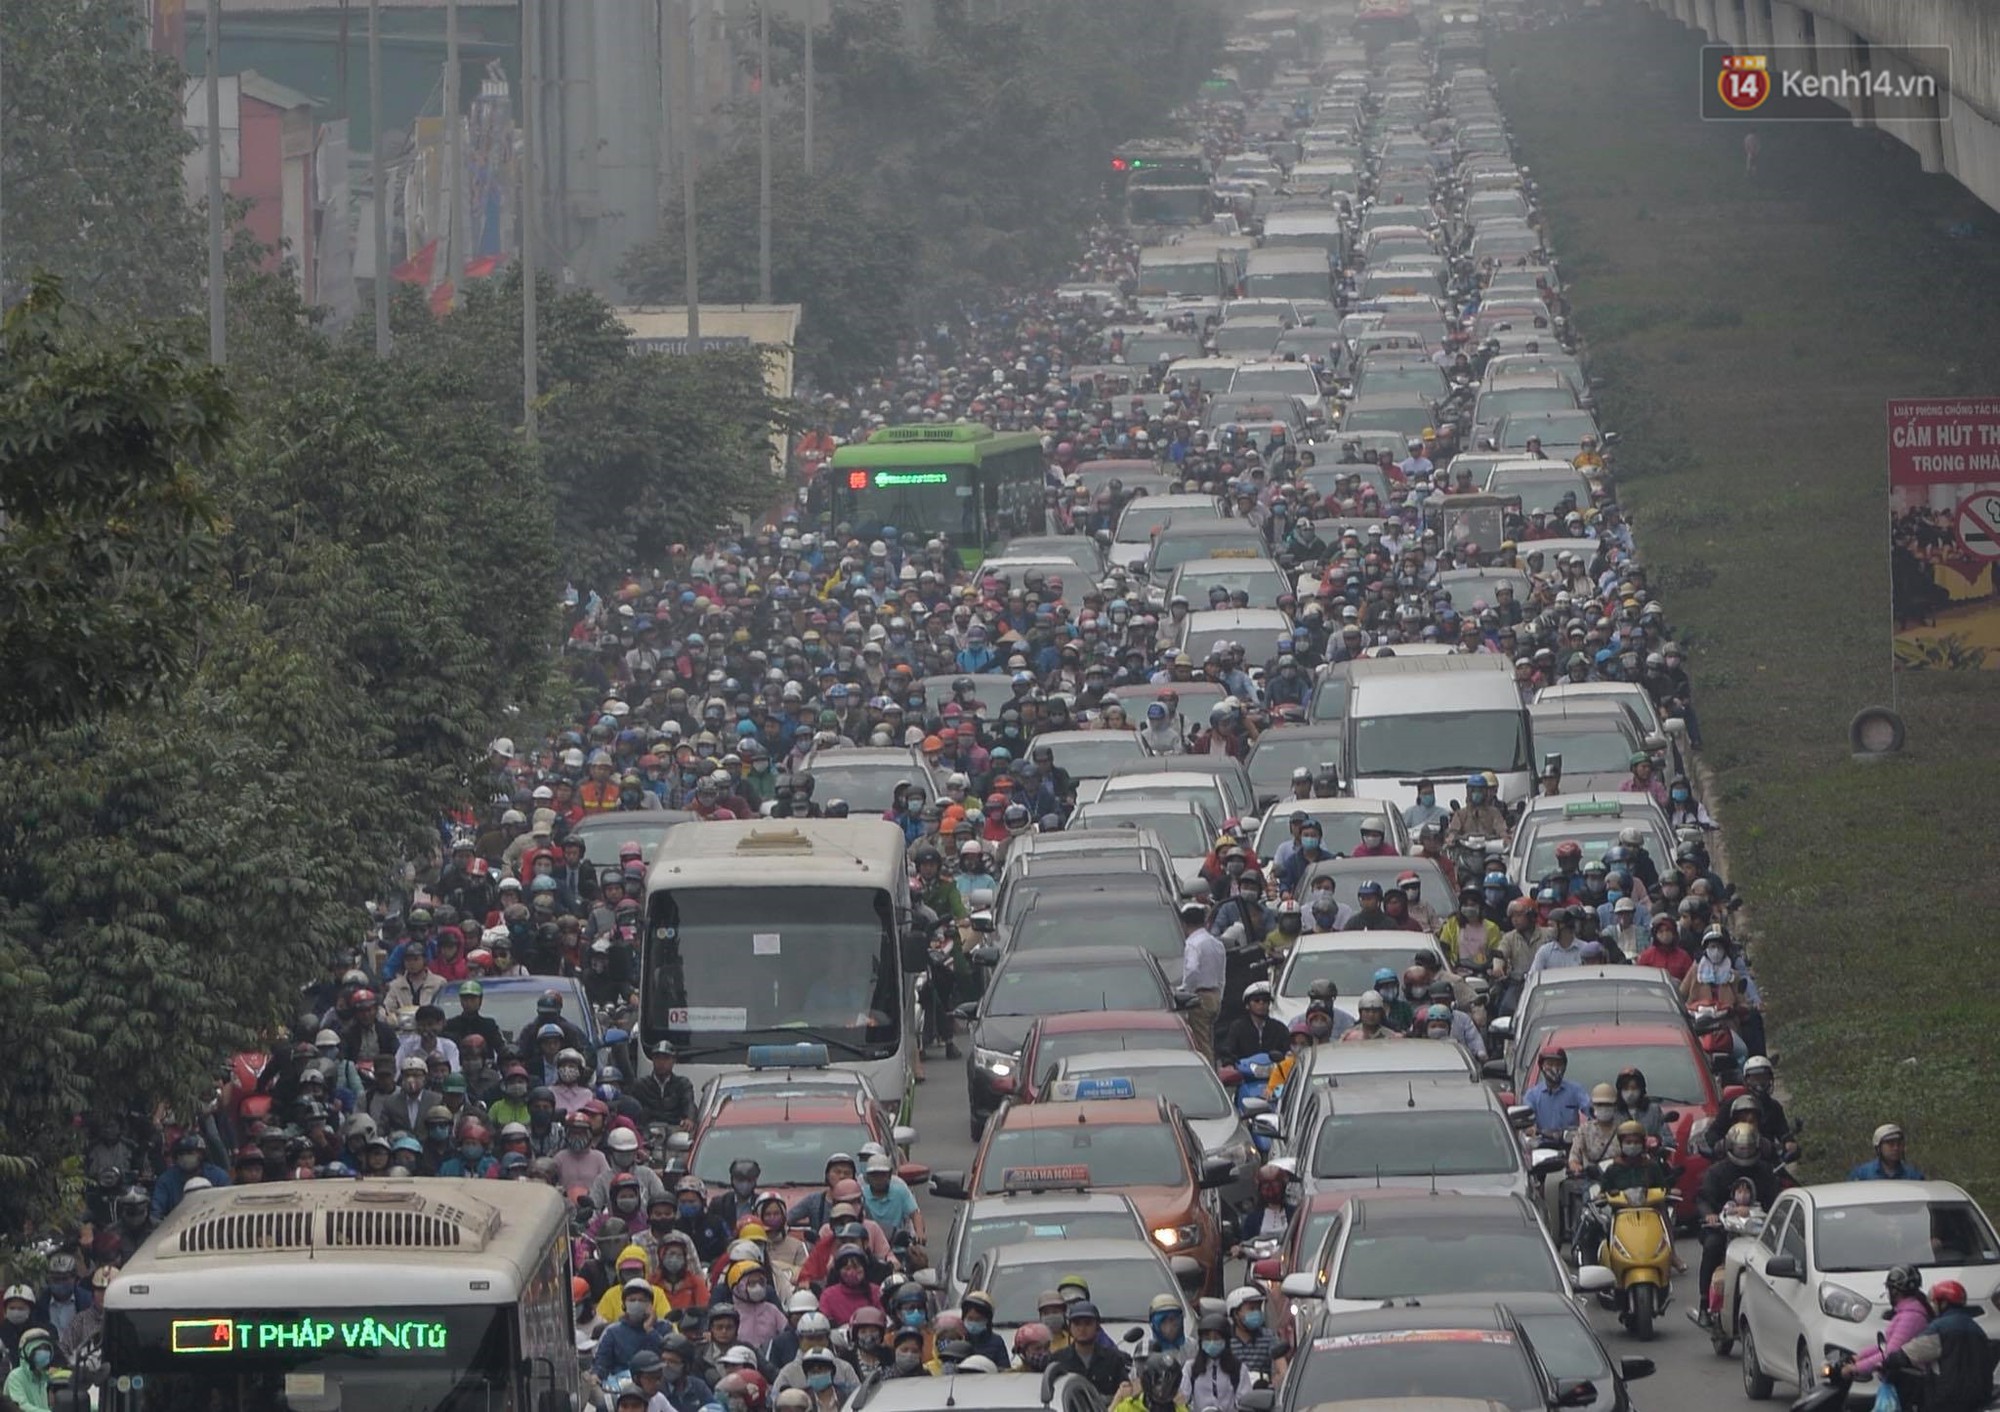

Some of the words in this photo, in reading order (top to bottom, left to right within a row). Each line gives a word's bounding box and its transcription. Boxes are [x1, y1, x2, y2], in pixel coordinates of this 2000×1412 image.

[1893, 417, 1932, 448] CẤM
[1936, 419, 1973, 447] HÚT
[1978, 424, 2000, 446] TH
[1912, 454, 1965, 472] TRONG
[1969, 449, 2000, 470] NHÀ
[670, 1010, 689, 1024] 03
[236, 1324, 253, 1348] T
[259, 1318, 335, 1348] PHÁP
